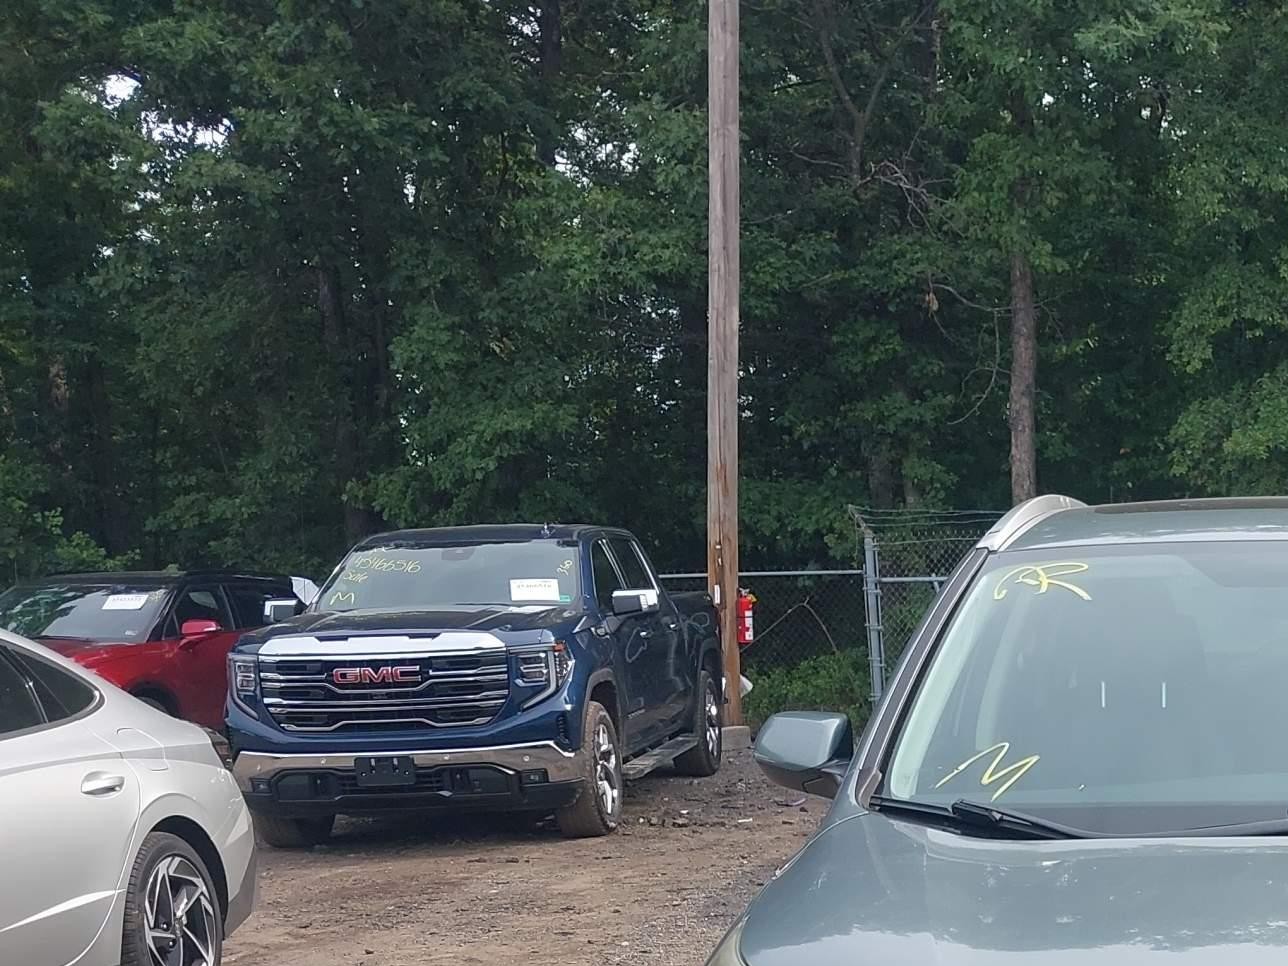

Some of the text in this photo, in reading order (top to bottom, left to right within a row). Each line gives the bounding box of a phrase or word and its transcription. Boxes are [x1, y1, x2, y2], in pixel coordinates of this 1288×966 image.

[329, 591, 355, 606] M
[332, 665, 421, 684] GMC
[934, 742, 1041, 802] M
